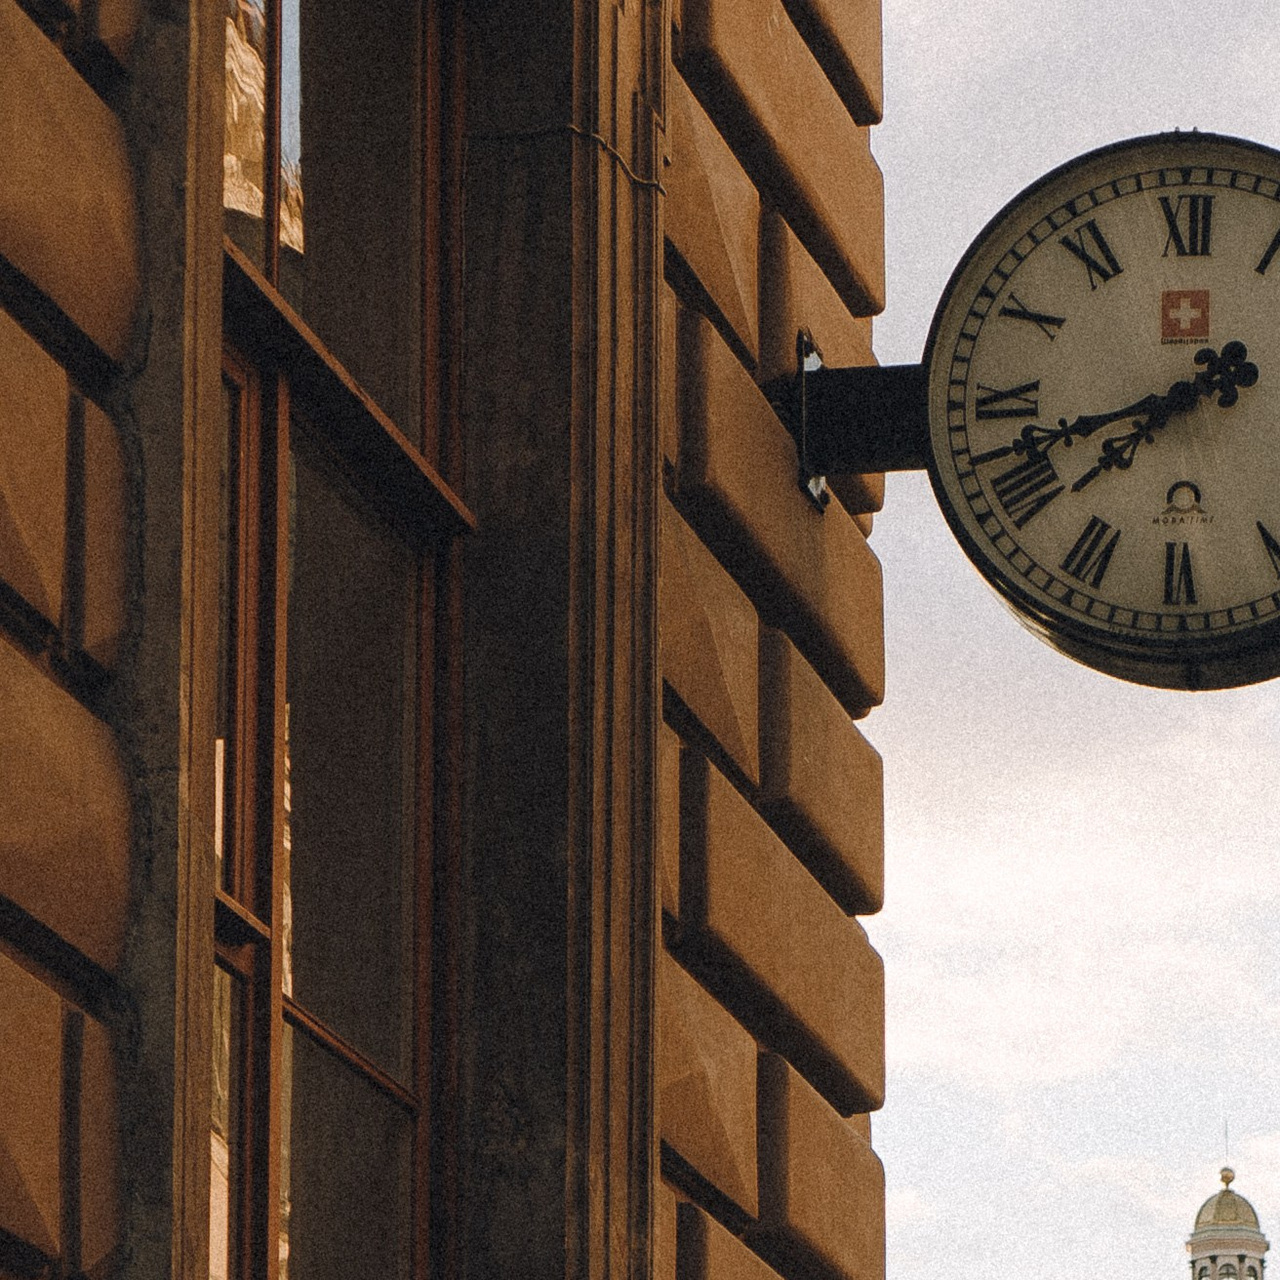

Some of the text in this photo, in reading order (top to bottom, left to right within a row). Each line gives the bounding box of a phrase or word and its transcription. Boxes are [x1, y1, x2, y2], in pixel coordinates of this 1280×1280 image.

[1058, 218, 1124, 292] XI
[1158, 194, 1215, 257] XII
[999, 292, 1067, 342] X
[975, 380, 1040, 422] IX
[1058, 514, 1122, 588] VII
[1152, 516, 1214, 526] MOBATIME
[1162, 541, 1198, 605] VI
